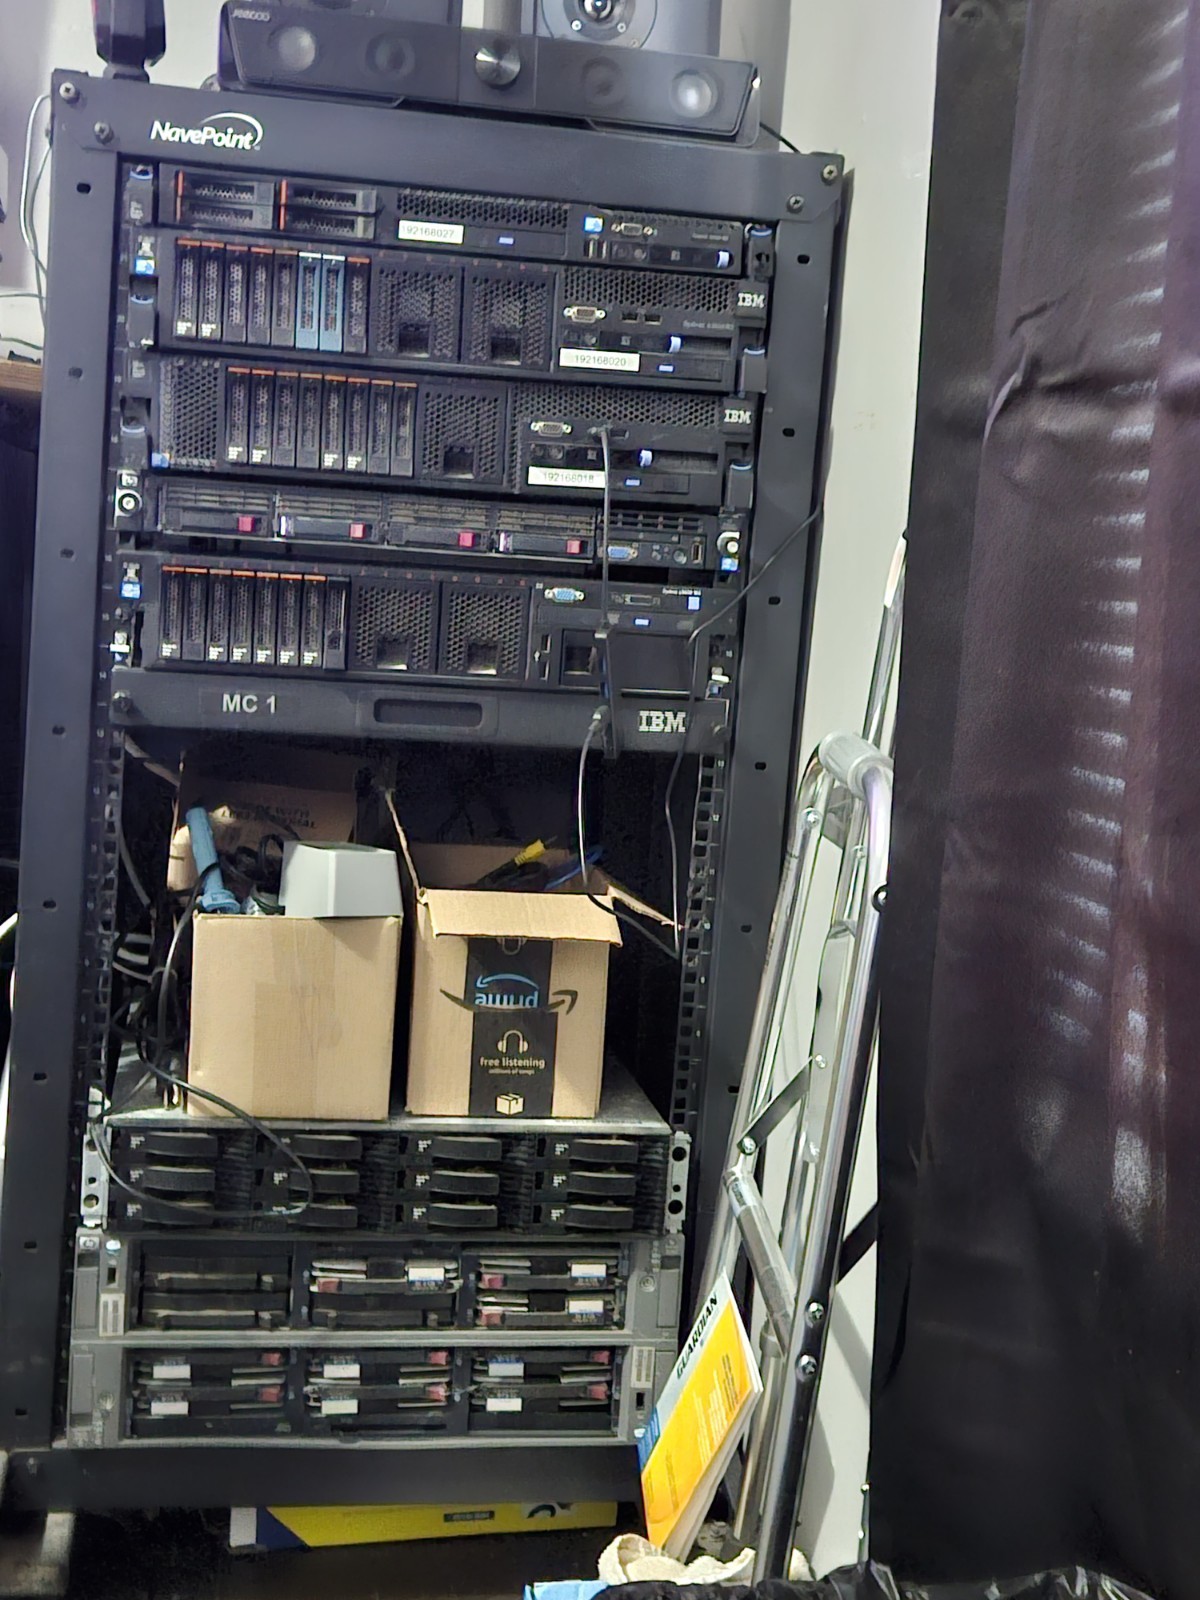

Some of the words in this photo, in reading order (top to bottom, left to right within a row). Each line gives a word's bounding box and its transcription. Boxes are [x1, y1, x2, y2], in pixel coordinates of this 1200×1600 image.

[150, 120, 253, 150] NavePoint
[402, 225, 455, 238] 192168027
[738, 293, 765, 308] IBM
[724, 409, 752, 424] IBM
[222, 693, 258, 714] MC
[266, 695, 276, 714] 1
[638, 710, 687, 733] IBM
[480, 1056, 500, 1067] free
[501, 1056, 546, 1069] listening
[676, 1293, 718, 1380] GUARDIAN
